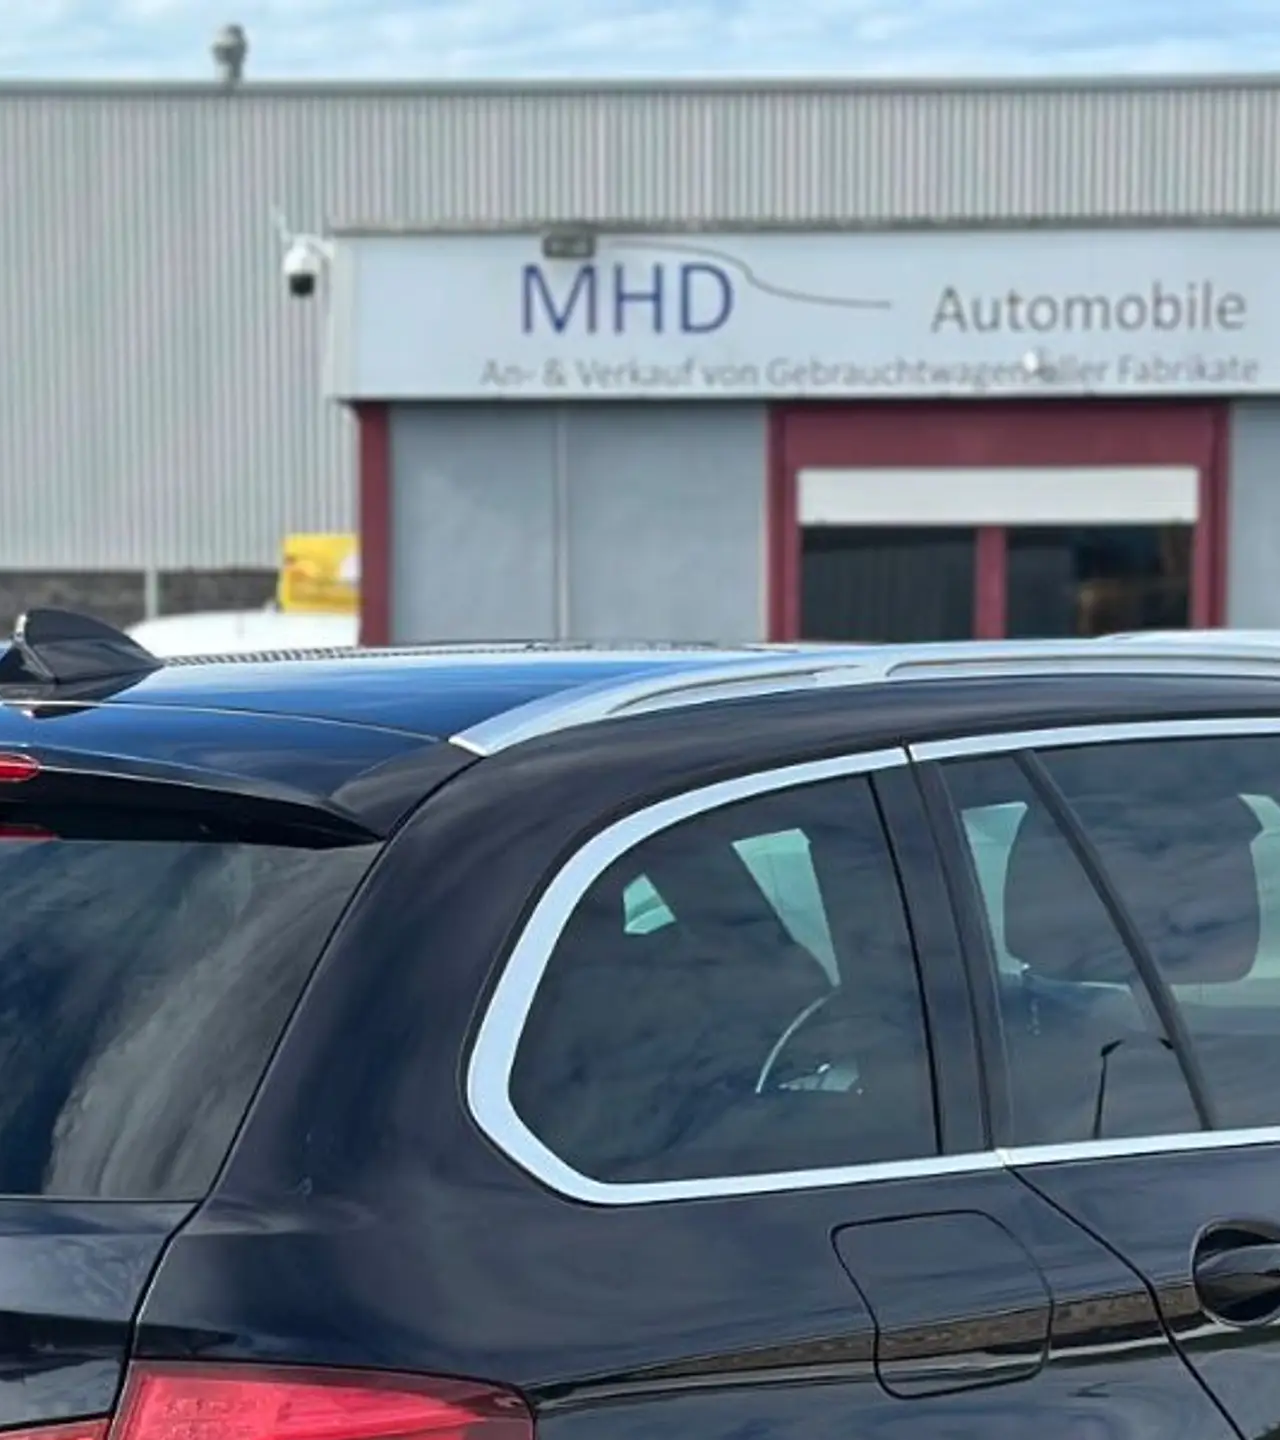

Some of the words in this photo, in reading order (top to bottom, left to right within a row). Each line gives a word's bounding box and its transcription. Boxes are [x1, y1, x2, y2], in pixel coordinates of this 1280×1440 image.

[522, 262, 734, 336] MHD
[931, 281, 1247, 334] Automobile
[479, 358, 536, 387] An-
[541, 357, 567, 387] &
[573, 357, 695, 388] Verkauf
[700, 364, 759, 387] von
[1117, 353, 1260, 385] Fabrikate
